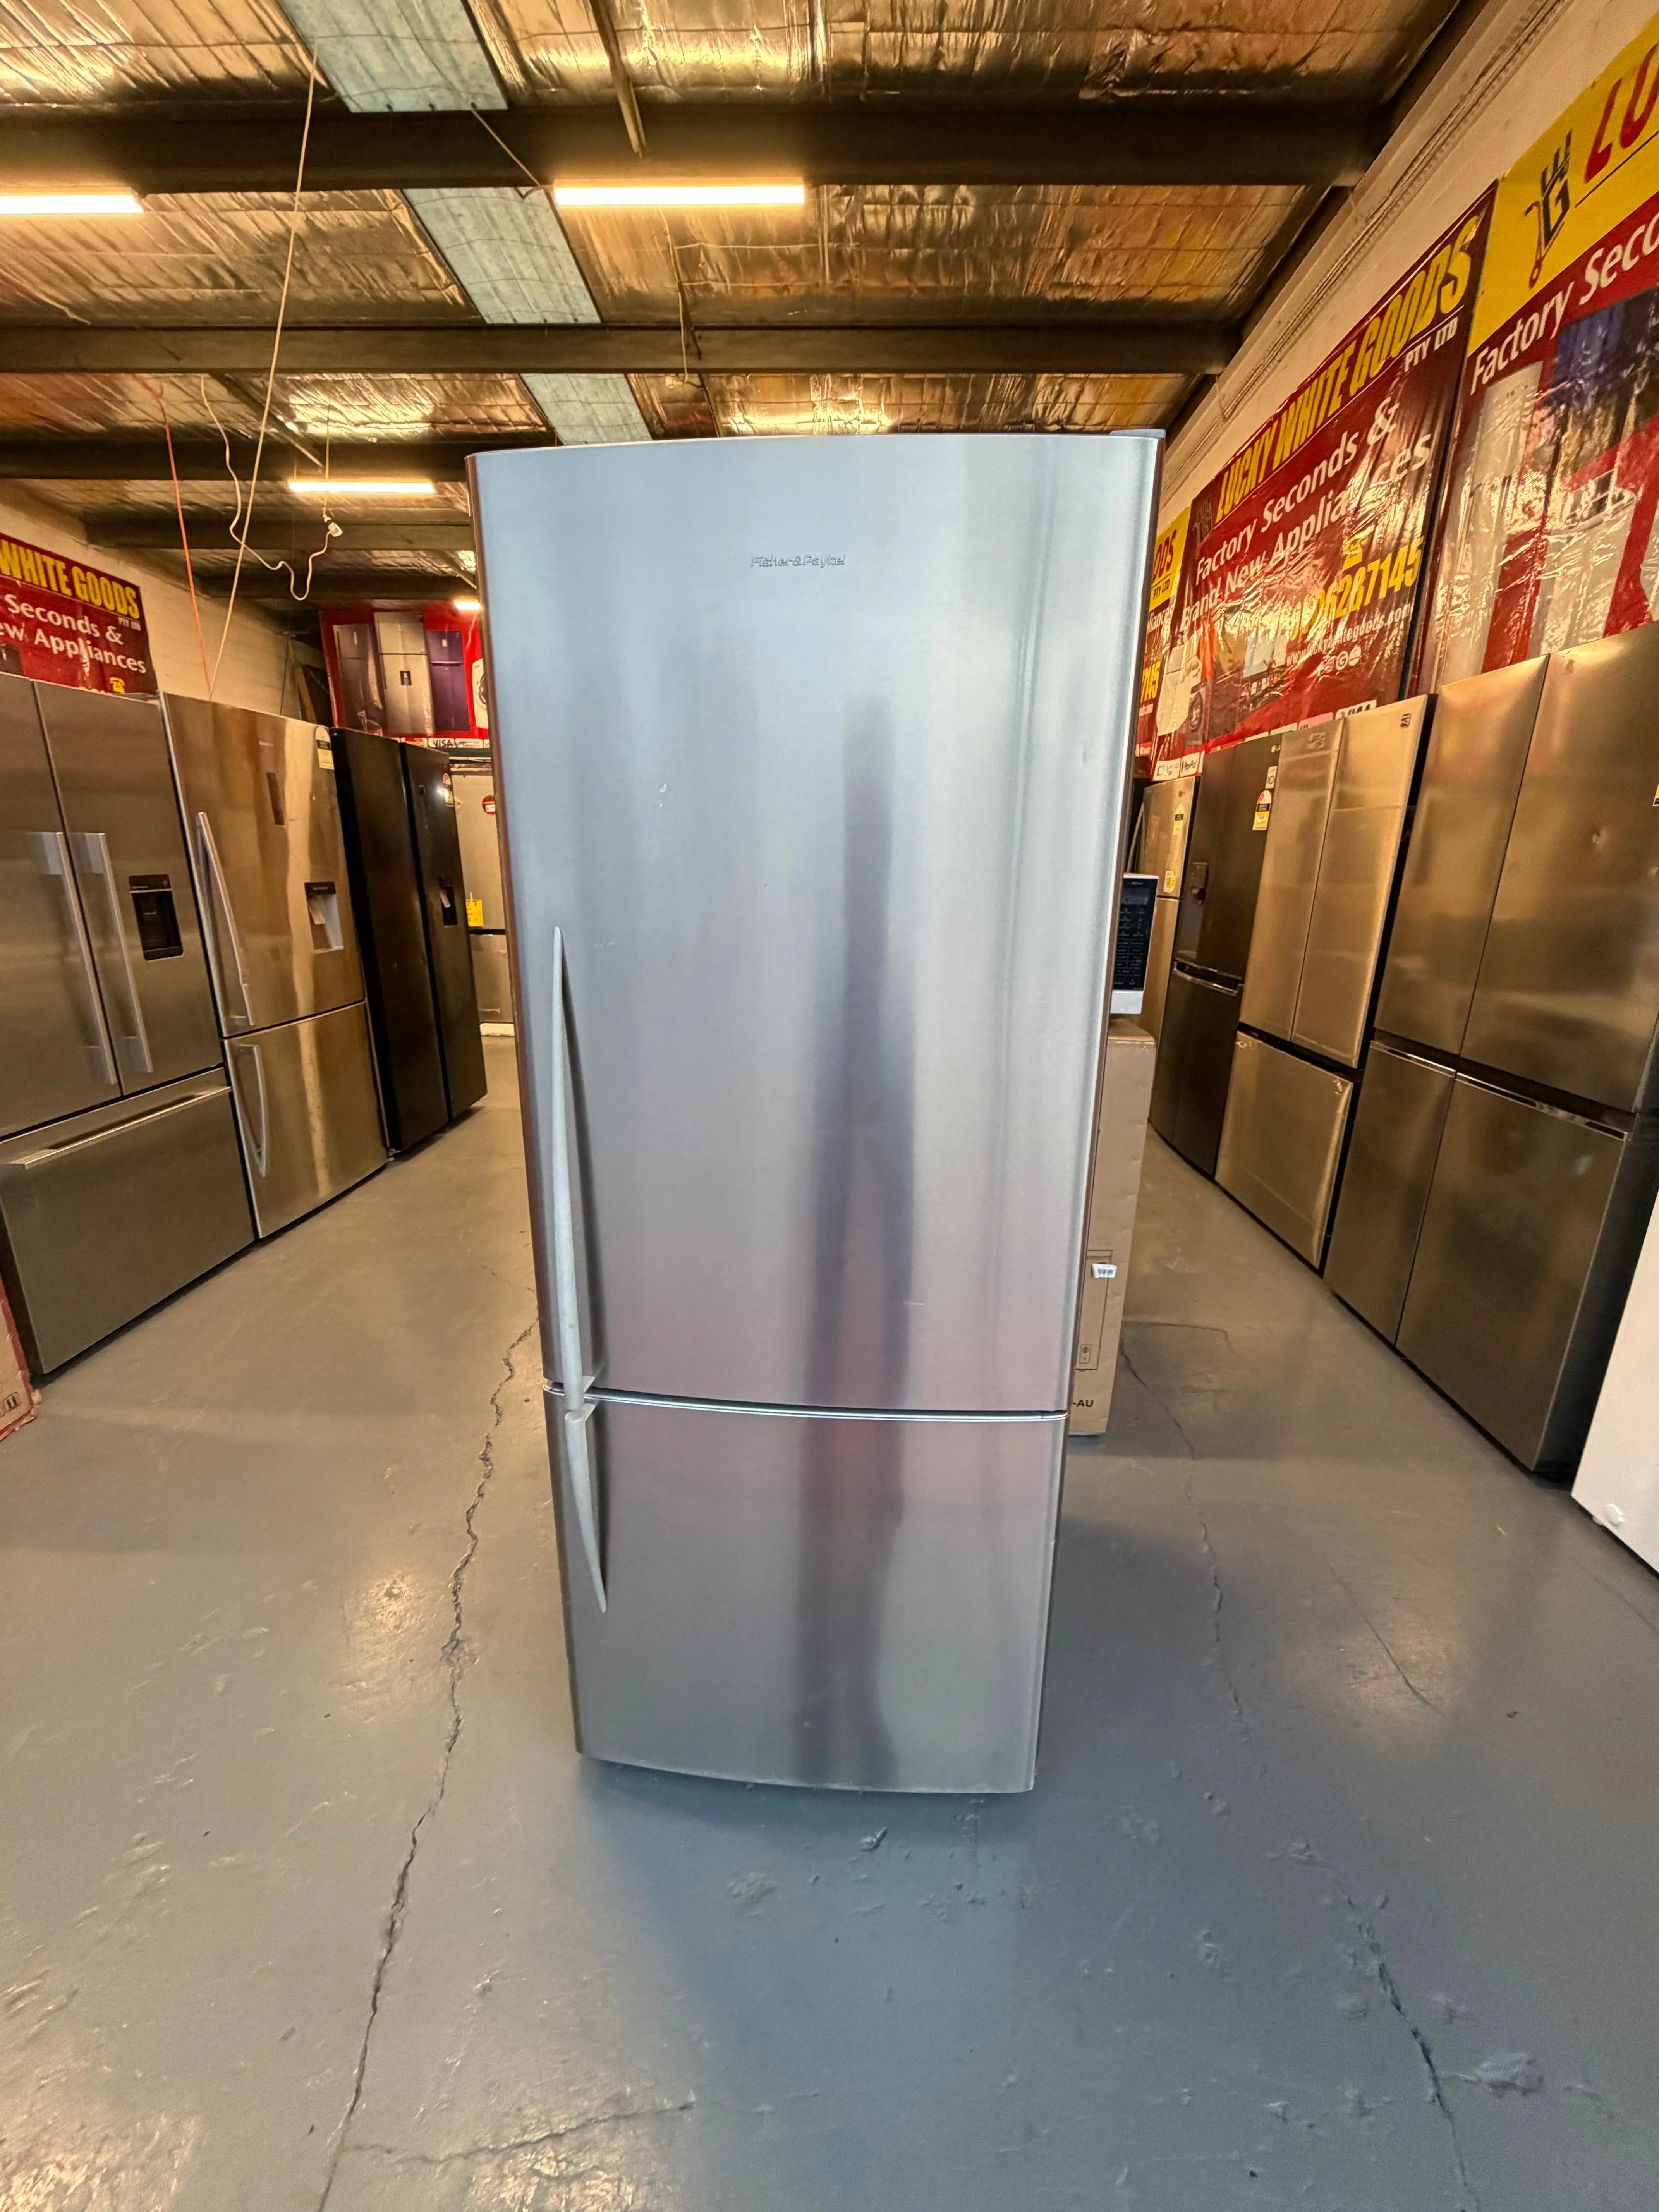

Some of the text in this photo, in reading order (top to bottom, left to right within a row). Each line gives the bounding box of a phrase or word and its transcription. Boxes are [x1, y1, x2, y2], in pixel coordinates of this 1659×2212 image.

[1216, 215, 1479, 524] LUCKY WHITE GOODS
[1404, 316, 1457, 372] PTY LTD
[1470, 281, 1575, 396] Factory
[1196, 397, 1400, 586] Factory Seconds &
[1179, 433, 1431, 632] Brand New Appliaces
[0, 539, 140, 619] WHITE GOODS
[1153, 578, 1170, 599] PTY LTD
[5, 594, 124, 645] Seconds &
[34, 628, 146, 673] Appliances
[433, 739, 453, 748] VISA
